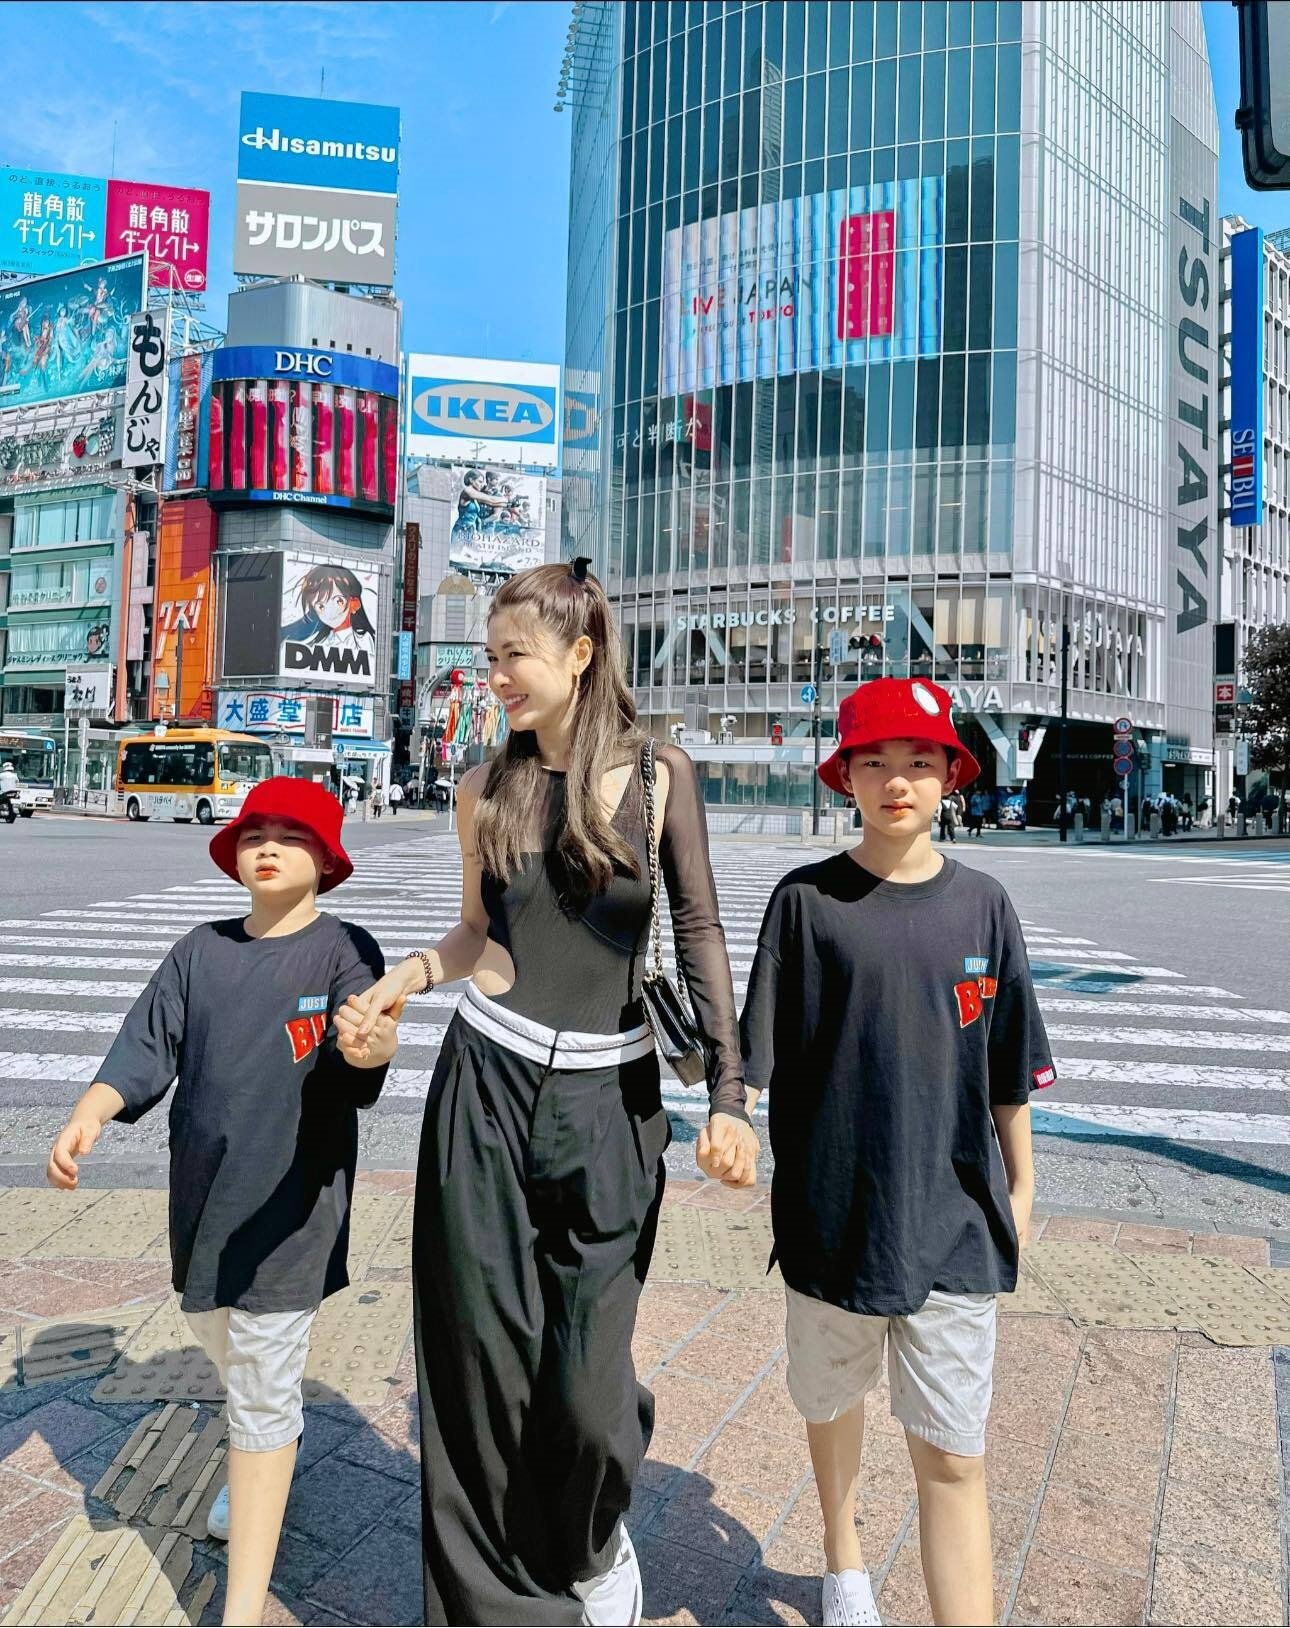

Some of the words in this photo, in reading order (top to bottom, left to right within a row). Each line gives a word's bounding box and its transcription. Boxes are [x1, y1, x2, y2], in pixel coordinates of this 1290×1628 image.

[241, 127, 396, 162] Hisamitsu
[23, 191, 86, 222] 龍角散
[129, 203, 189, 234] 龍角散
[12, 218, 97, 249] ダイレクト
[246, 210, 385, 257] サロンパス
[748, 304, 794, 323] TOKO
[275, 351, 333, 376] DHC
[126, 314, 165, 460] もんじゃ
[427, 396, 543, 425] IKEA
[1177, 197, 1210, 635] TSUTAYA
[1232, 428, 1255, 510] SEIBU
[272, 491, 293, 501] DHC
[293, 493, 328, 504] Channel
[677, 608, 796, 631] STARBUCKS
[810, 605, 895, 622] COFFEE
[284, 644, 371, 676] DMM
[1218, 686, 1232, 700] 本
